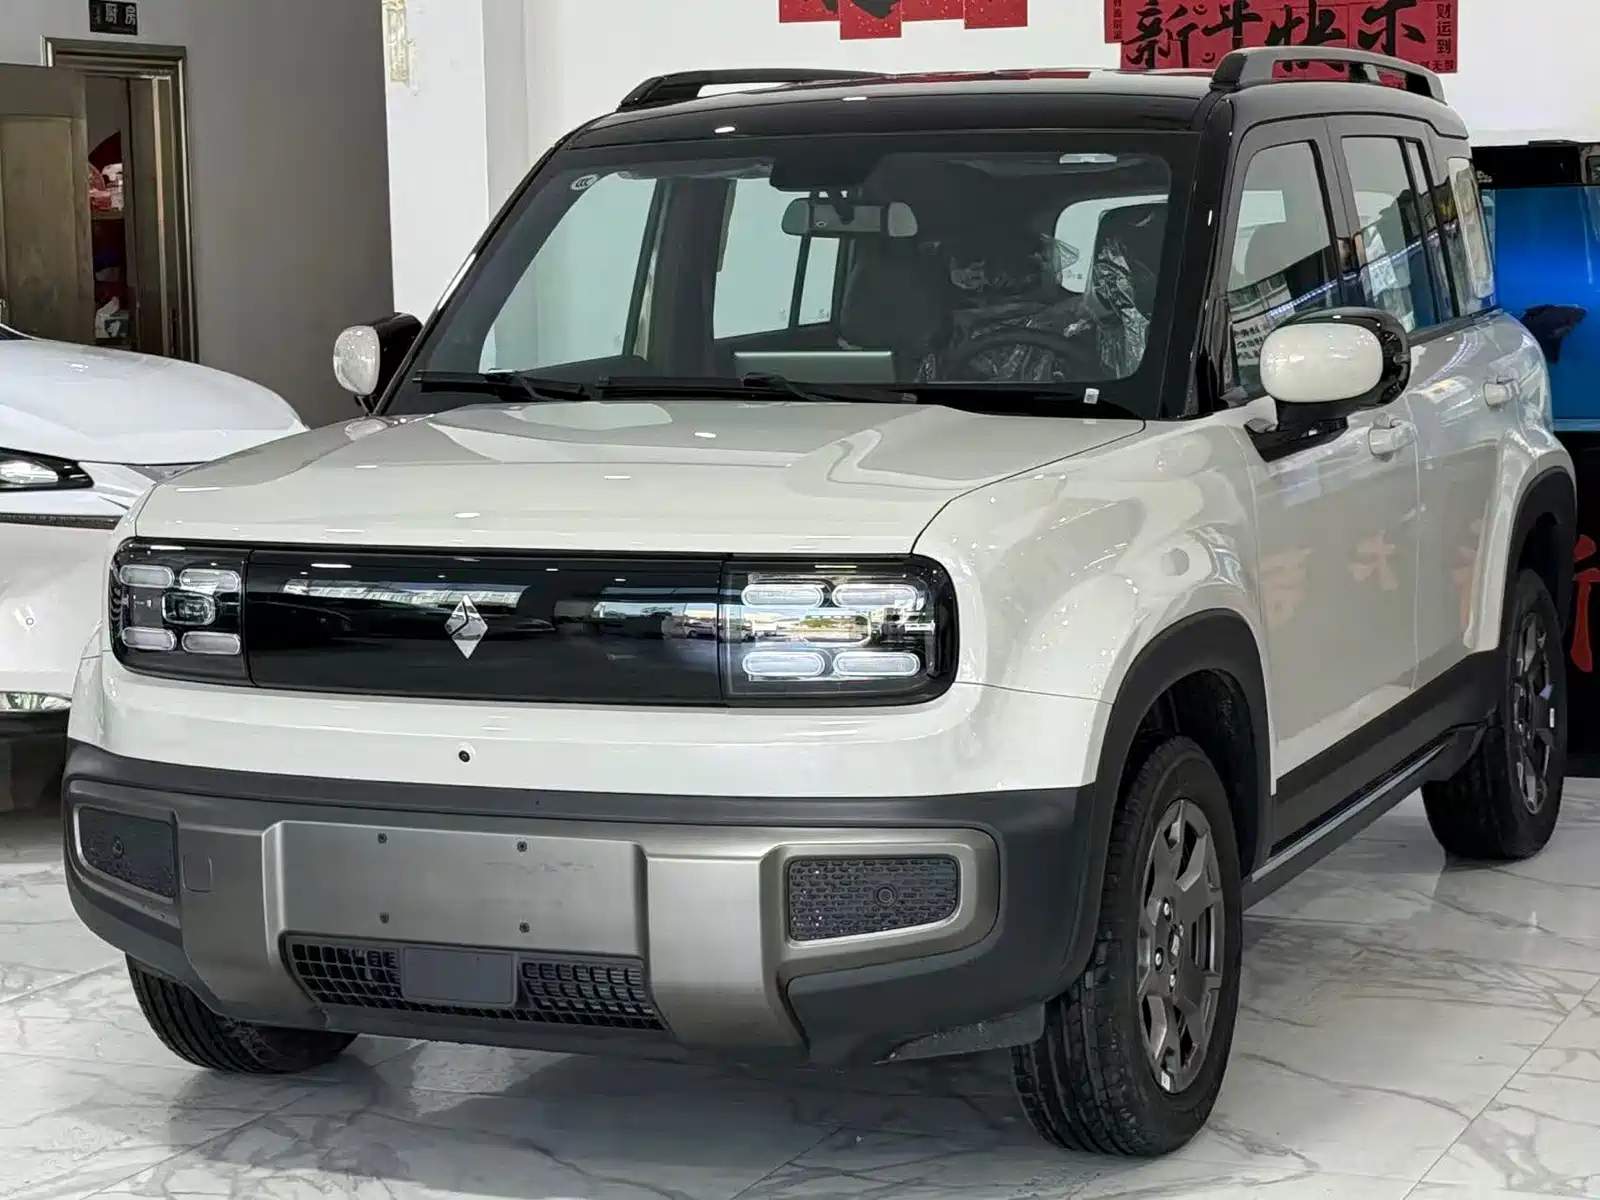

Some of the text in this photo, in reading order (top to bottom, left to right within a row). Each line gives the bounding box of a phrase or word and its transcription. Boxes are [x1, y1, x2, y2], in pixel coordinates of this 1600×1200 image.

[105, 3, 136, 25] 厨房
[1436, 3, 1452, 54] 财运到
